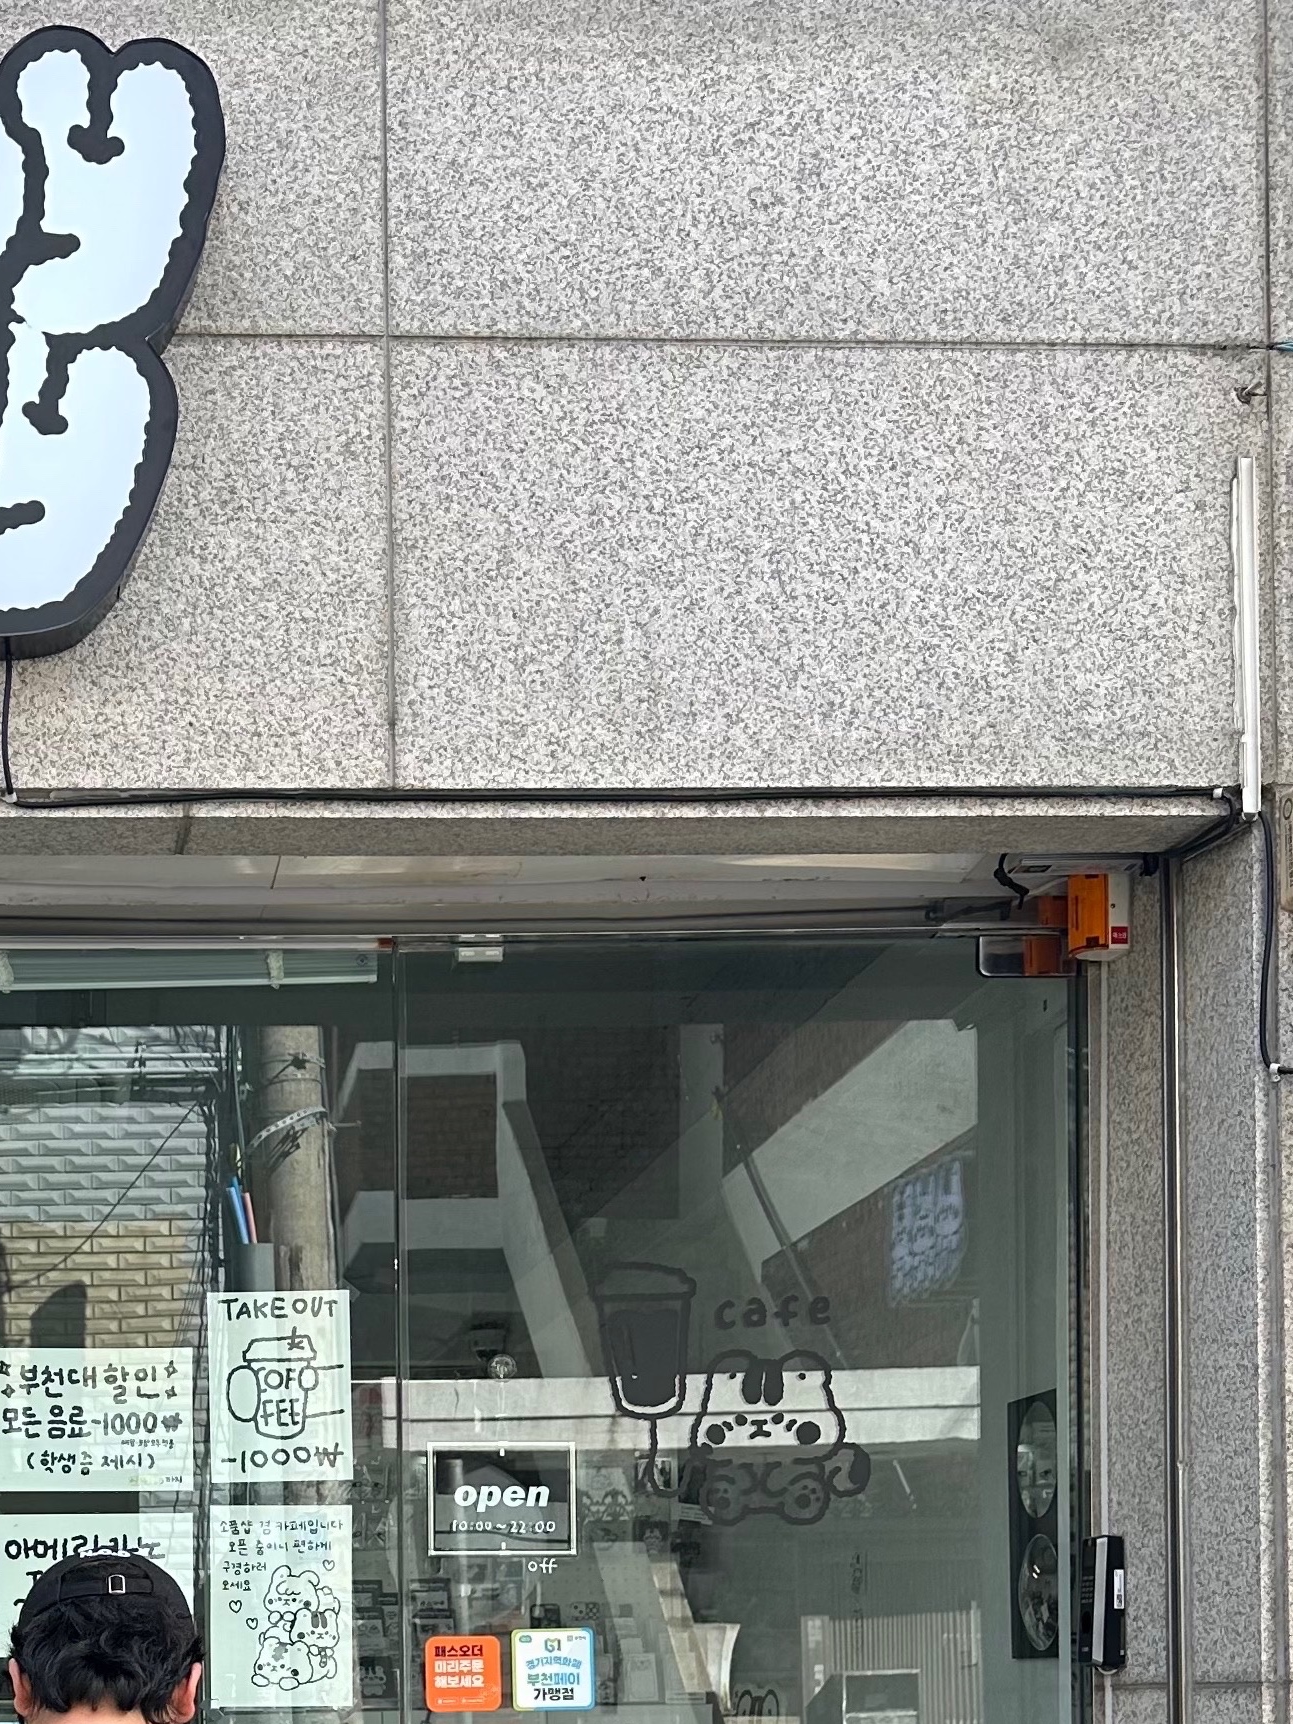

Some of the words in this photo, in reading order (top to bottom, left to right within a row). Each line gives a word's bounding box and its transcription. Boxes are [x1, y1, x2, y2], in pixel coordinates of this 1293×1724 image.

[714, 1295, 831, 1329] cafe
[19, 1364, 97, 1398] 부천대
[103, 1363, 160, 1404] 할인
[2, 1405, 42, 1439] 모든
[453, 1484, 550, 1513] open
[220, 1519, 254, 1535] 소품샵
[275, 1519, 344, 1535] 카페입니다
[228, 1539, 248, 1556] 오픈
[255, 1539, 288, 1555] 중이니
[292, 1539, 332, 1554] 편하게
[222, 1560, 267, 1576] 구경하러
[527, 1557, 558, 1574] off
[222, 1579, 251, 1591] 오세요
[434, 1645, 484, 1657] 패스오더
[434, 1659, 485, 1674] 미리주문
[434, 1675, 485, 1689] 해보세요
[527, 1672, 580, 1686] 부천페이
[534, 1688, 575, 1701] 가맹점
